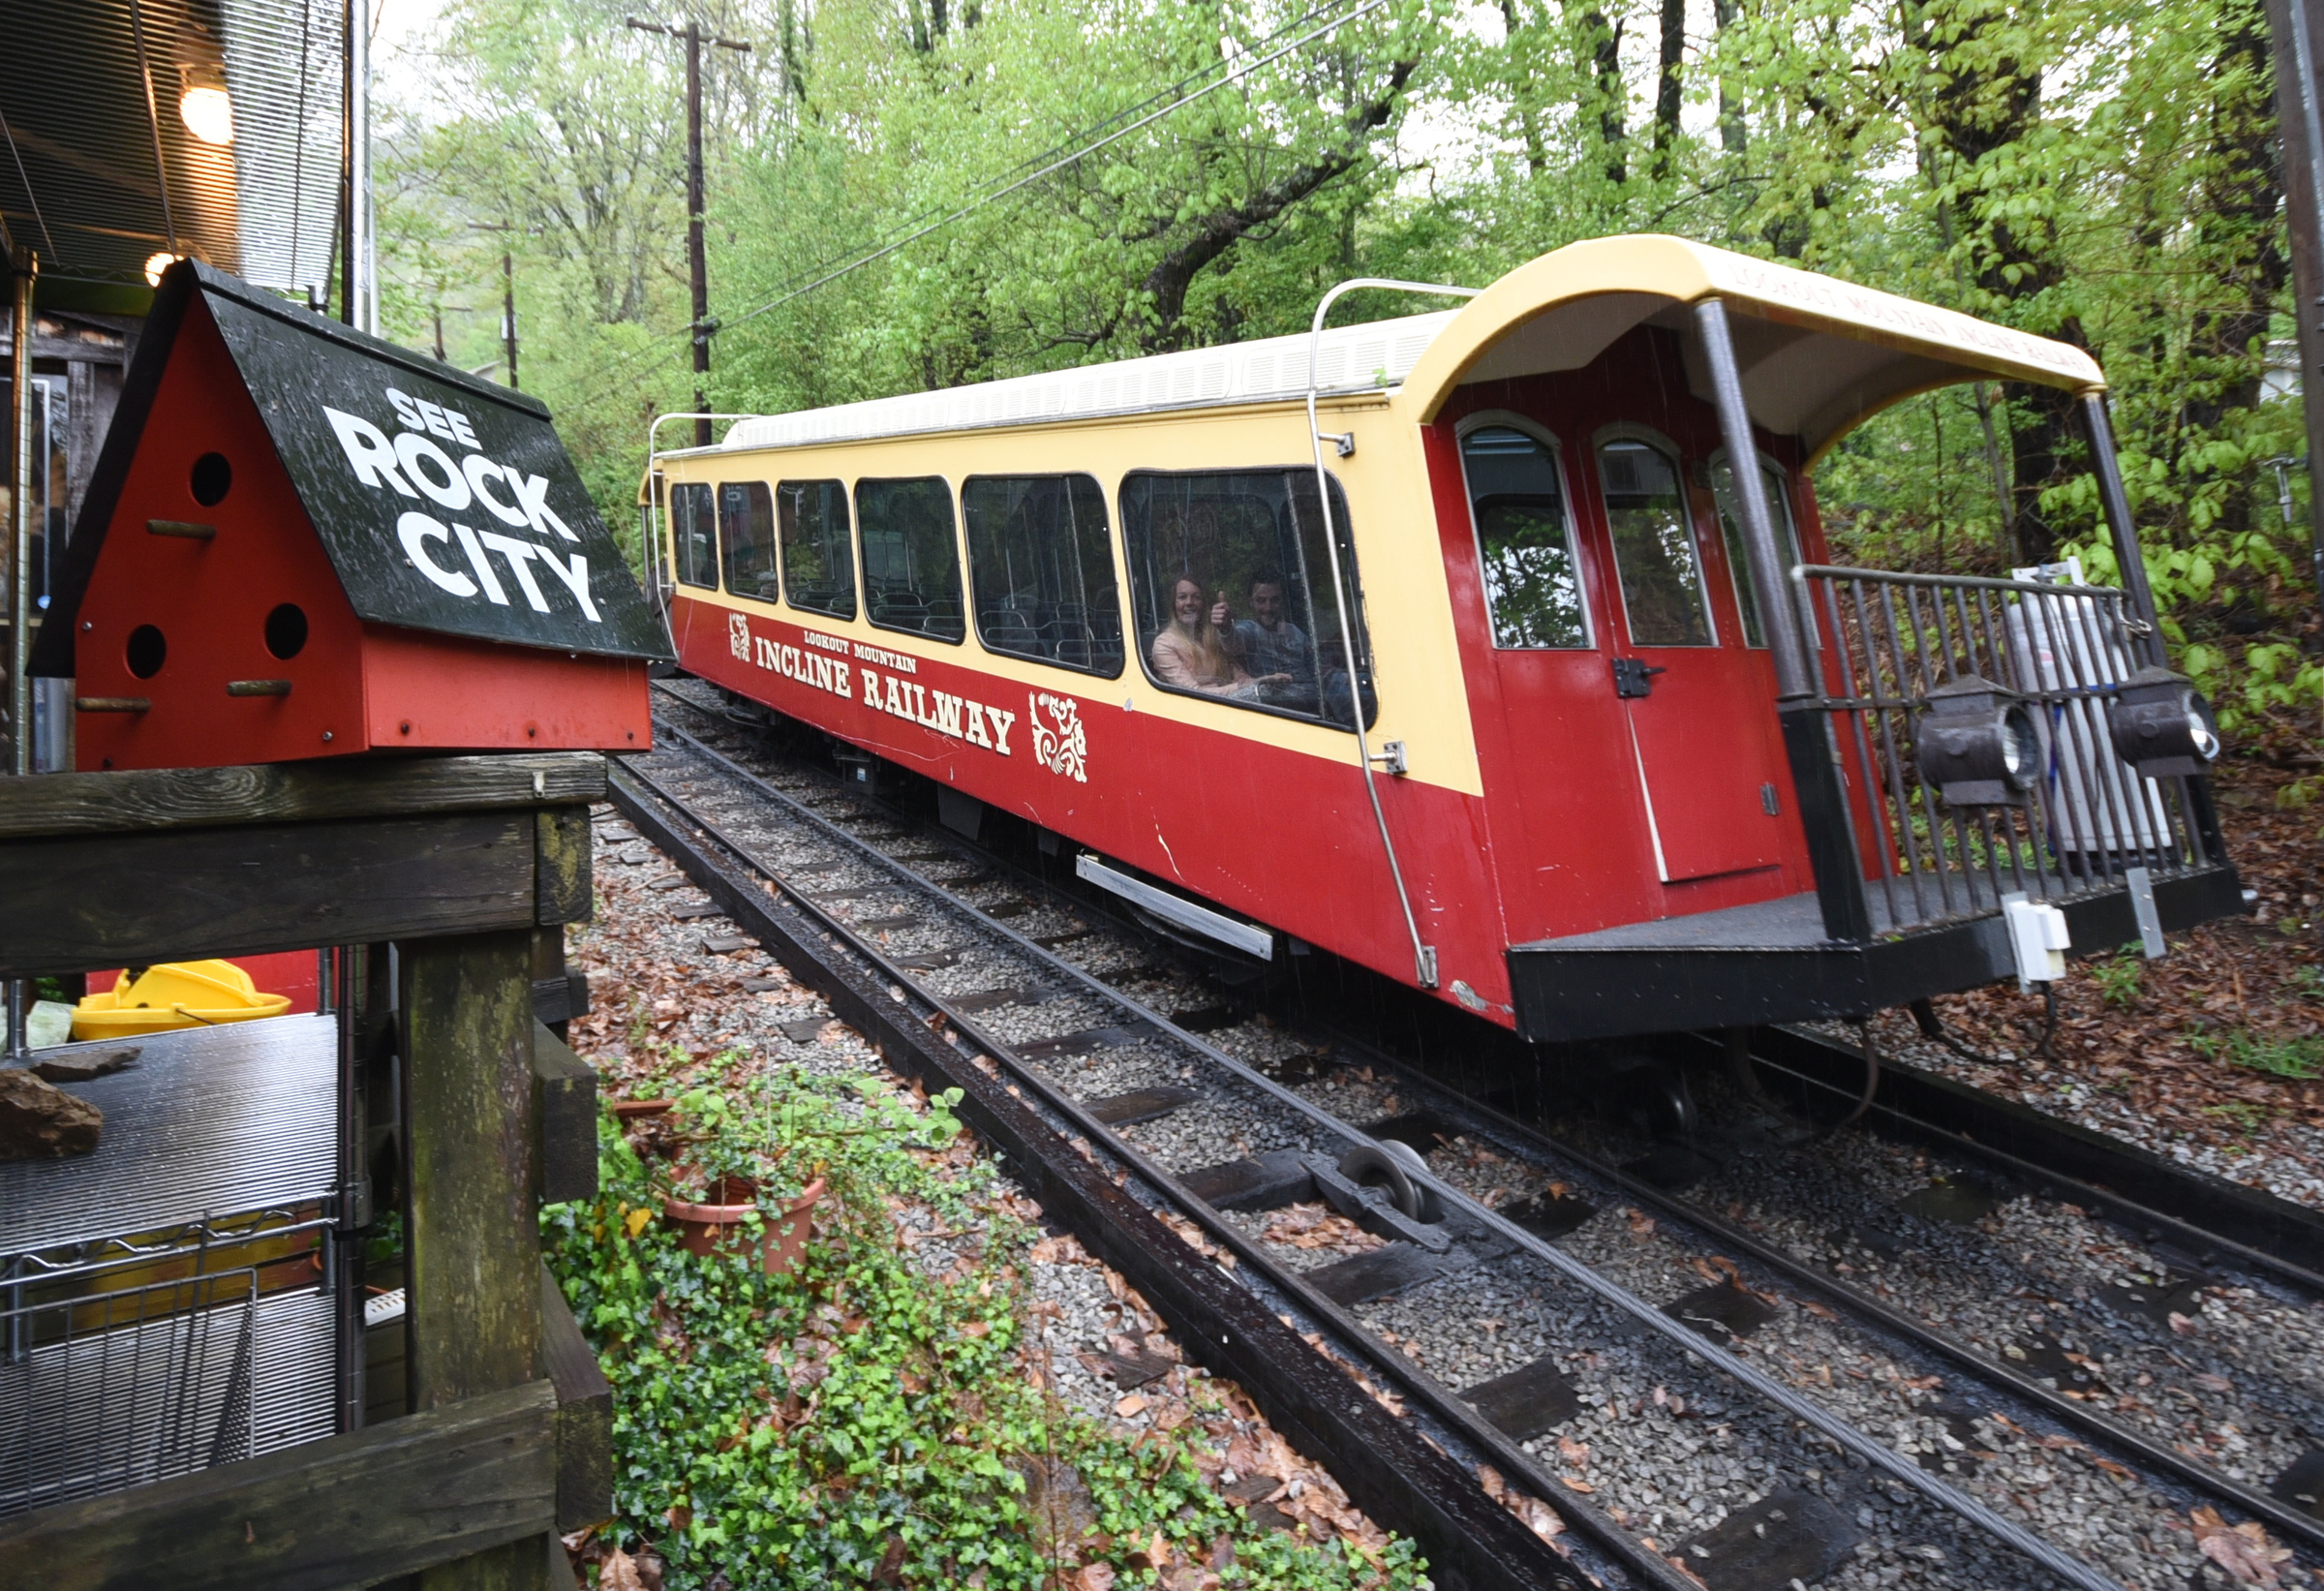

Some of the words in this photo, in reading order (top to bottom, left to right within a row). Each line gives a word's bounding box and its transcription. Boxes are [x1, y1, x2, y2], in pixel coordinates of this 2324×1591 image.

[1728, 263, 1838, 304] LOOKOUT
[1844, 293, 1947, 337] MOUNTAIN
[385, 387, 483, 450] SEE
[321, 405, 581, 542] ROCK
[396, 511, 602, 623] CITY
[755, 636, 852, 699] INCLINE
[861, 668, 1016, 755] RAILWAY
[803, 629, 849, 655] LOOKOUT
[853, 643, 916, 674] MOUNTAIN
